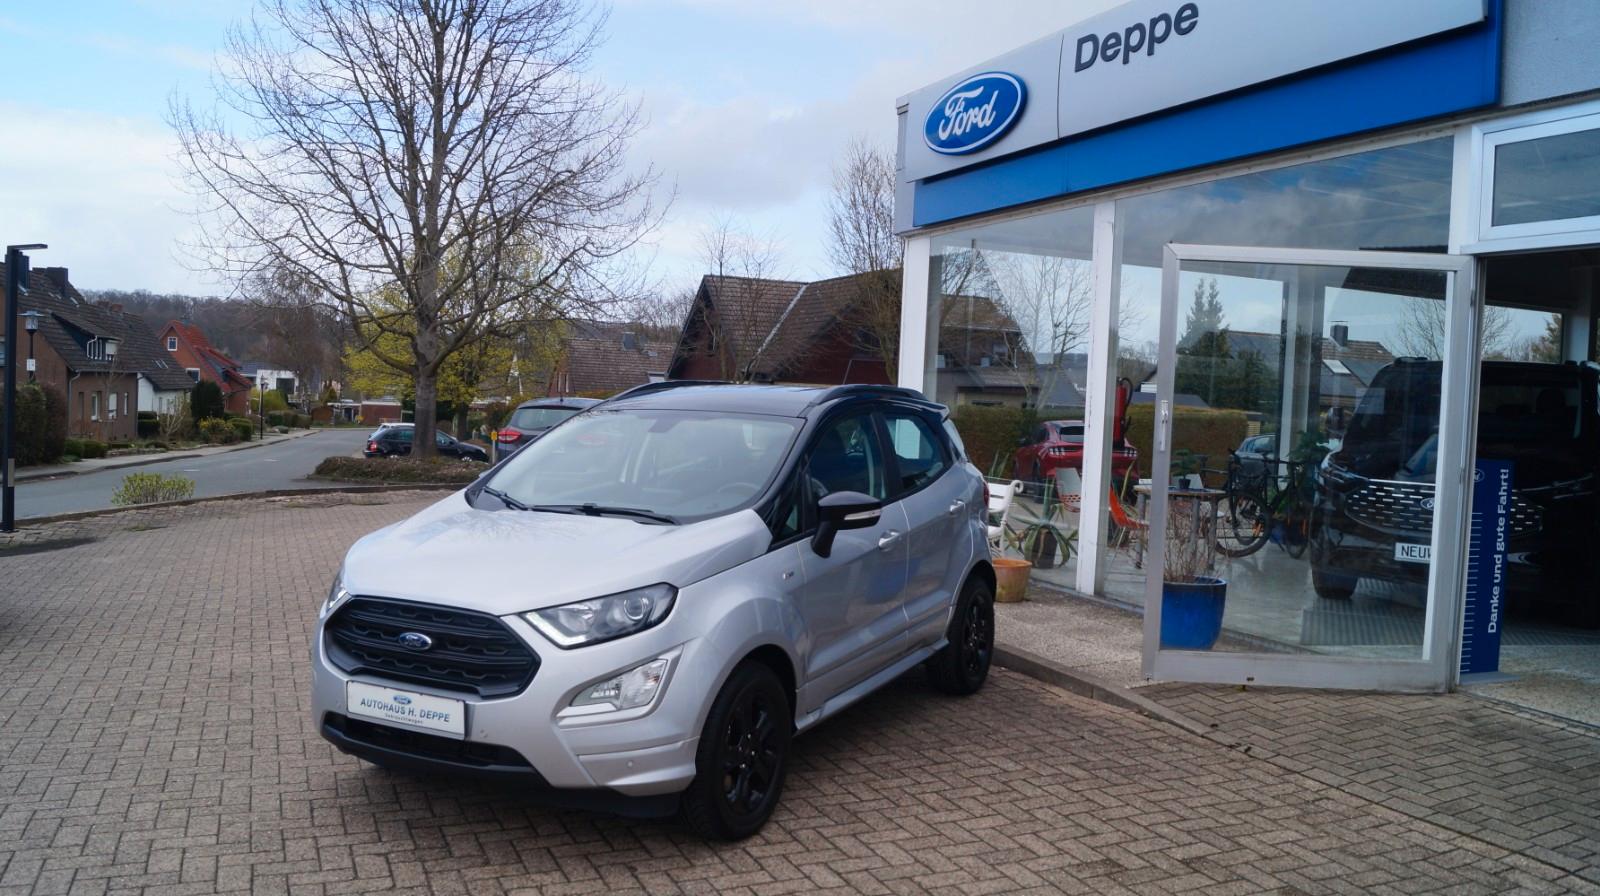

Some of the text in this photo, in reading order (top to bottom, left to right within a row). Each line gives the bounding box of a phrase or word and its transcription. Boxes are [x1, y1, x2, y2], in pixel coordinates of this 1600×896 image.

[1074, 2, 1199, 72] Deppe
[938, 86, 997, 141] Ford
[1488, 469, 1509, 633] Danke und gute Fahrt!
[360, 698, 405, 715] AUTOHAUS
[407, 708, 417, 717] H.
[419, 709, 450, 722] DEPPE
